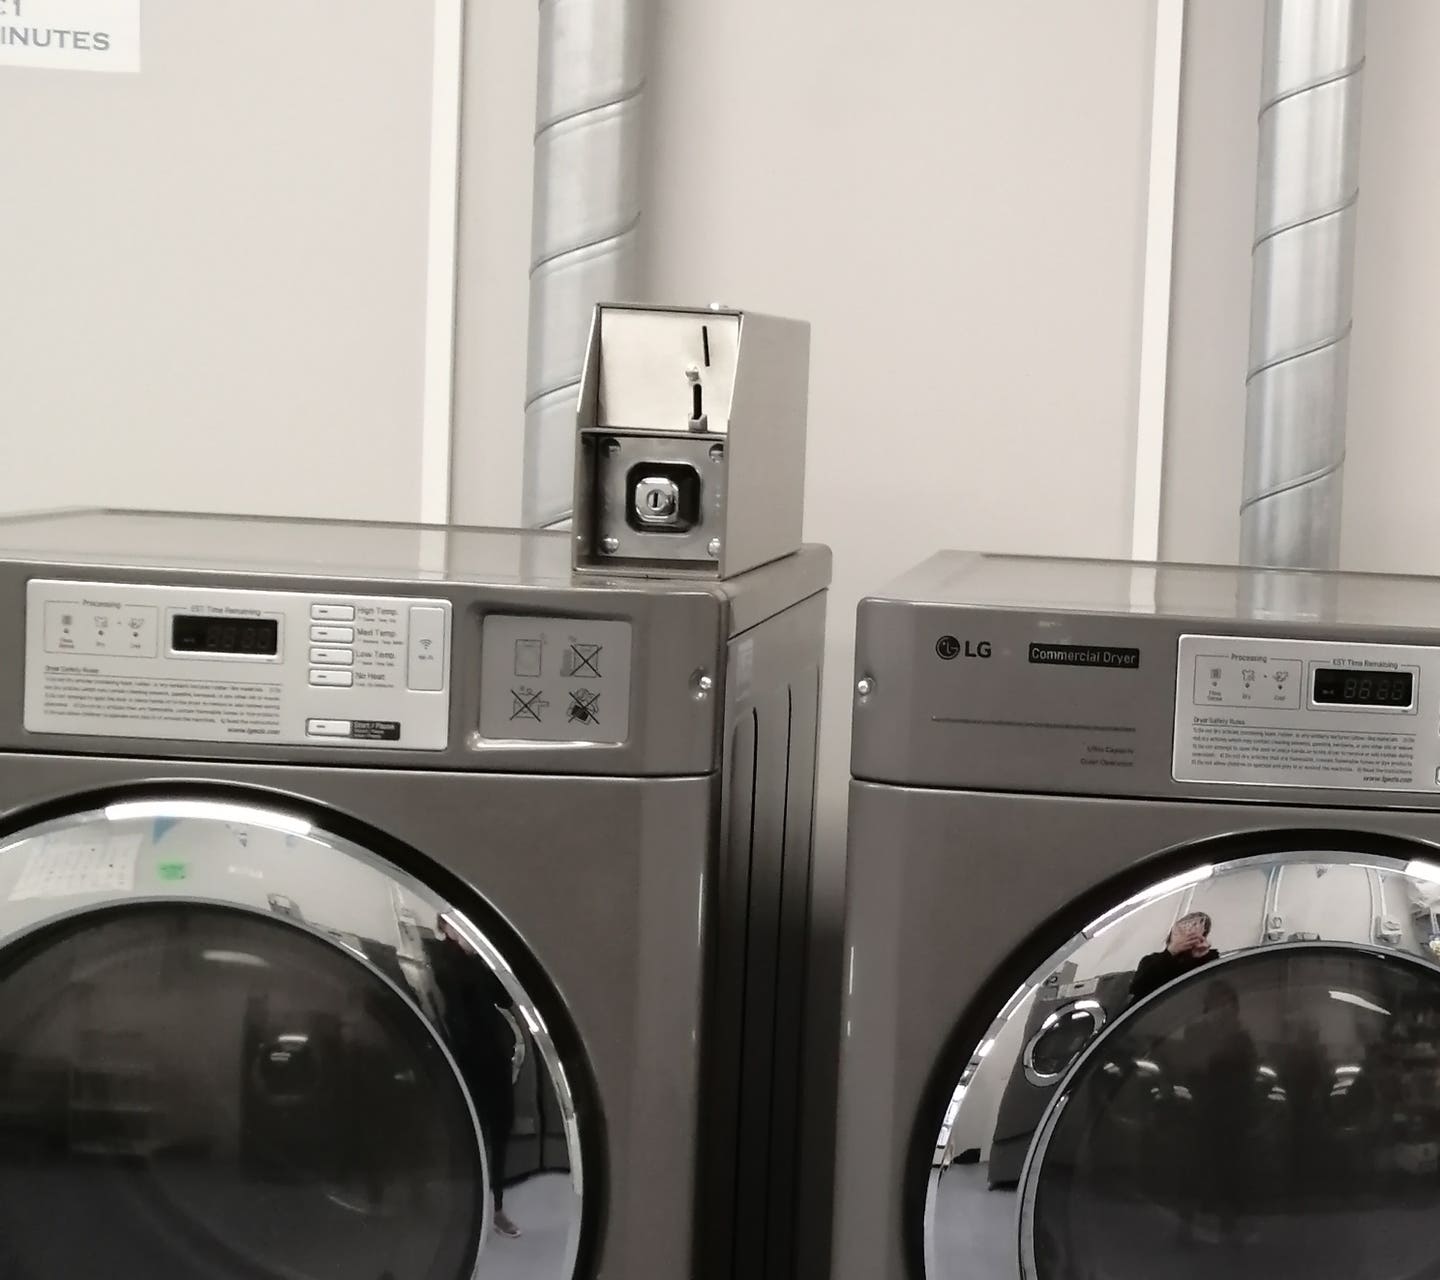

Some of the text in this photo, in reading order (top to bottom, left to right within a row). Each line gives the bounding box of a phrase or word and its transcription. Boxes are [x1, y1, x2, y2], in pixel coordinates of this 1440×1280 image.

[964, 640, 992, 658] LG
[1031, 647, 1136, 666] Commercial Dryer
